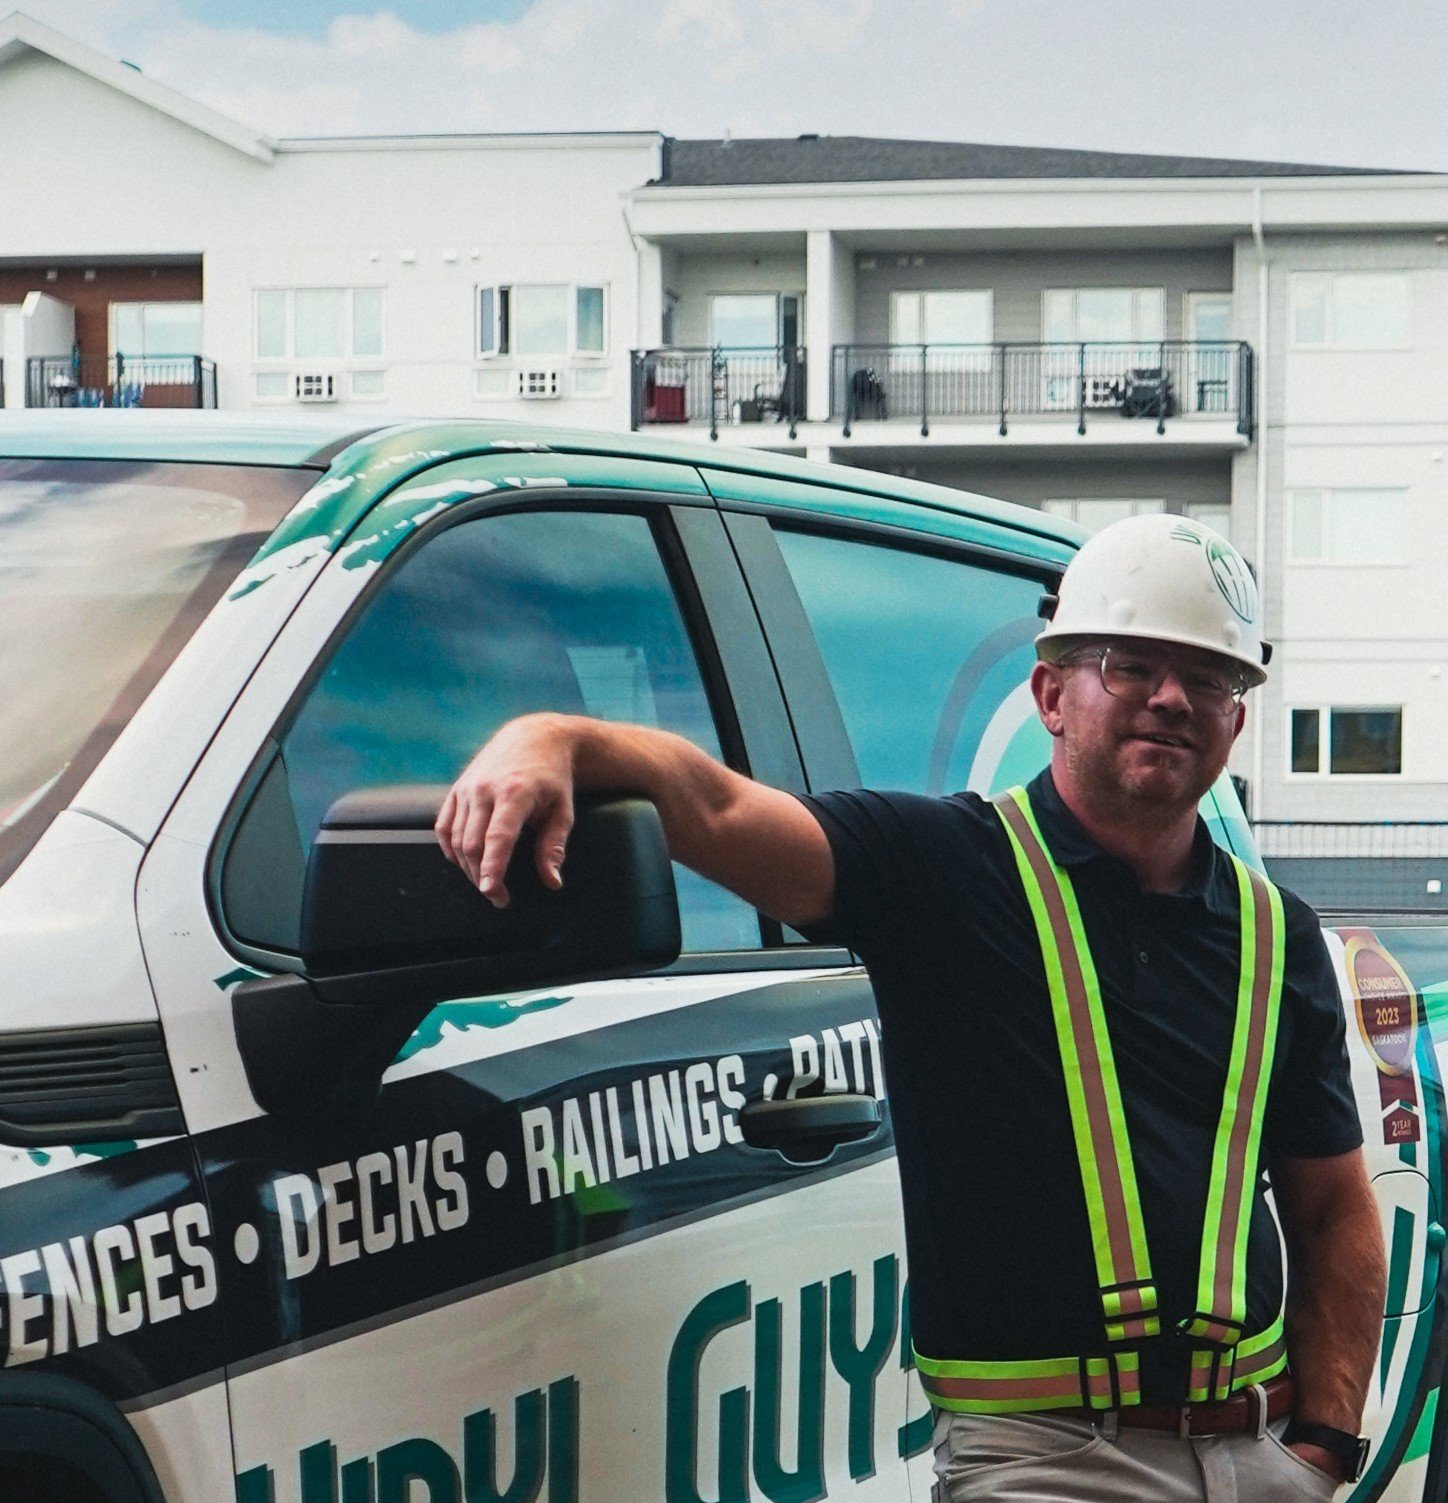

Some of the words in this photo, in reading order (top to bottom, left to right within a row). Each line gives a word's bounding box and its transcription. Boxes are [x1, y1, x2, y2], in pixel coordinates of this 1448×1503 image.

[1375, 1007, 1400, 1025] 2023
[0, 1201, 218, 1368] ENCES
[273, 1130, 470, 1281] DECKS
[521, 1054, 747, 1206] RAILINGS
[786, 1018, 882, 1101] PATI
